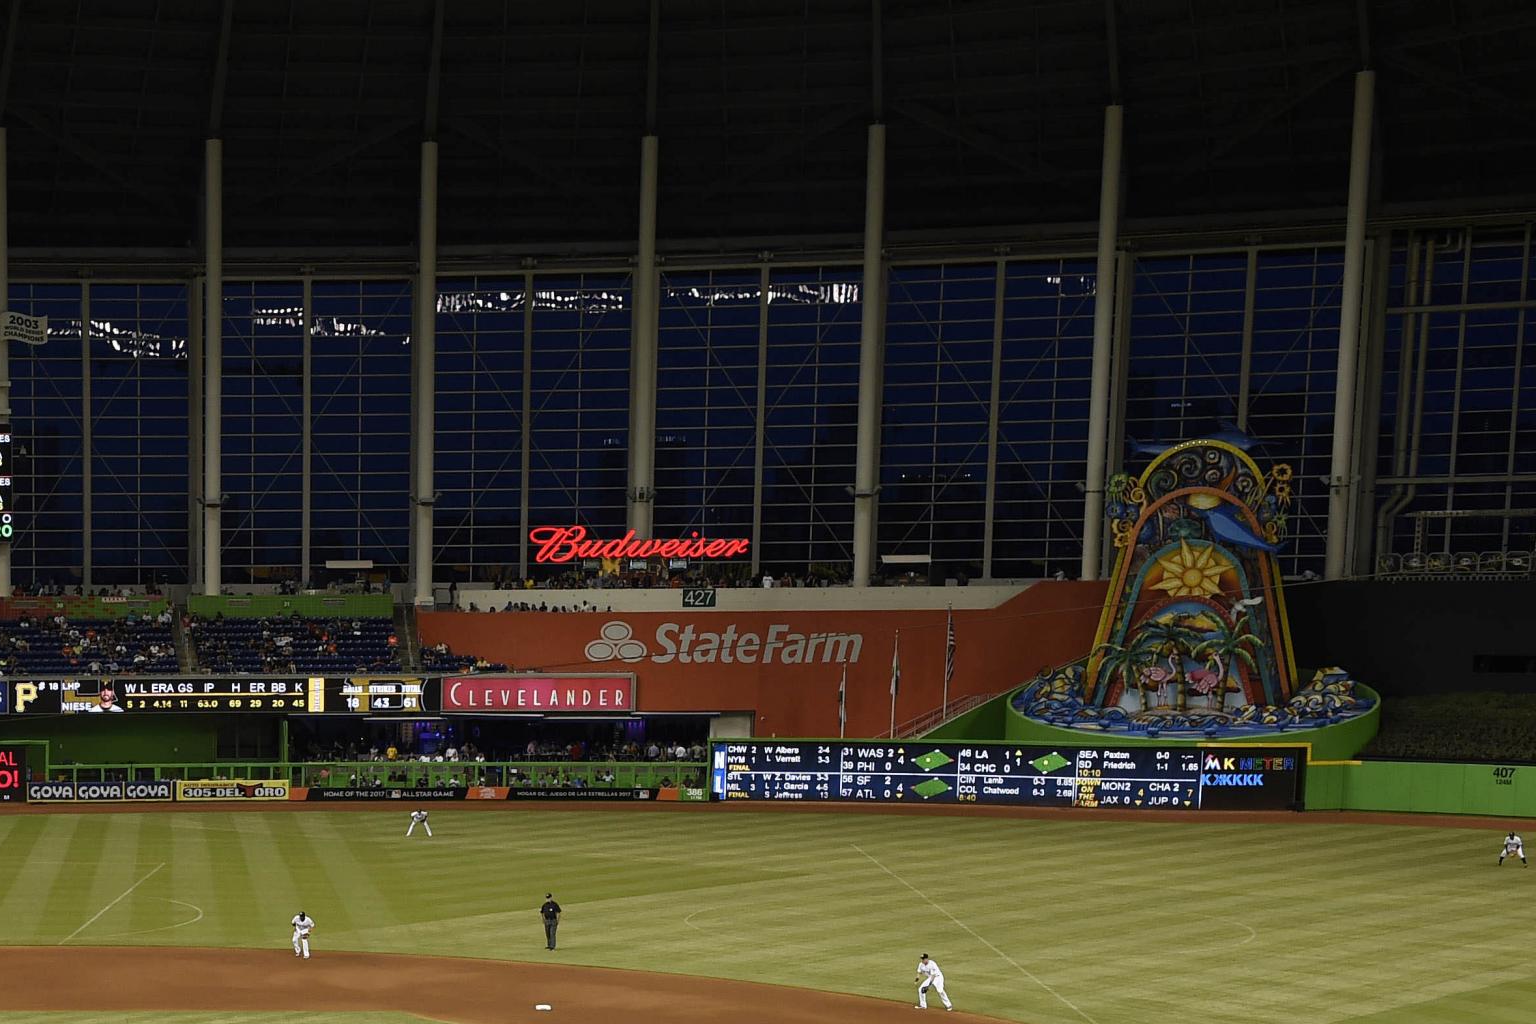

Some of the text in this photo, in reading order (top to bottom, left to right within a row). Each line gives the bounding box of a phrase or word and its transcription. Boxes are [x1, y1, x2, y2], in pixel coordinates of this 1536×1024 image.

[9, 315, 39, 329] 2003
[4, 331, 44, 342] CHAMPIONS
[530, 525, 750, 564] Budweiser
[684, 590, 714, 607] 427
[49, 682, 81, 691] 18 LHP
[125, 683, 303, 693] W L ERA GS IP H ER BB K
[450, 682, 624, 706] CLEVELANDER
[62, 702, 92, 711] NIESE
[197, 700, 218, 708] 63.0
[229, 700, 241, 708] 69
[250, 700, 262, 708] 29
[373, 698, 390, 708] 43
[858, 749, 884, 758] WAS
[975, 750, 989, 759] LA
[1079, 750, 1170, 759] SEA Paxton 0-0
[728, 755, 745, 763] NYM
[1224, 757, 1235, 770] K
[857, 762, 875, 771] PHI
[959, 763, 996, 772] 34 CHC
[1079, 760, 1092, 769] SD
[1103, 760, 1136, 769] Friedrich
[1182, 763, 1199, 771] 1.65
[1079, 769, 1101, 777] 10:10
[1493, 767, 1516, 778] 407
[857, 776, 871, 785] SF
[984, 776, 1004, 784] Lamb
[31, 786, 73, 798] GOYA
[79, 785, 120, 798] GOYA
[126, 785, 168, 798] GOYA
[254, 787, 285, 797] ORO
[959, 786, 1019, 795] COL Chatwood
[1149, 783, 1171, 792] CHA
[842, 788, 876, 798] 57 ATL
[1100, 796, 1119, 805] JAX
[1149, 796, 1168, 806] JUP
